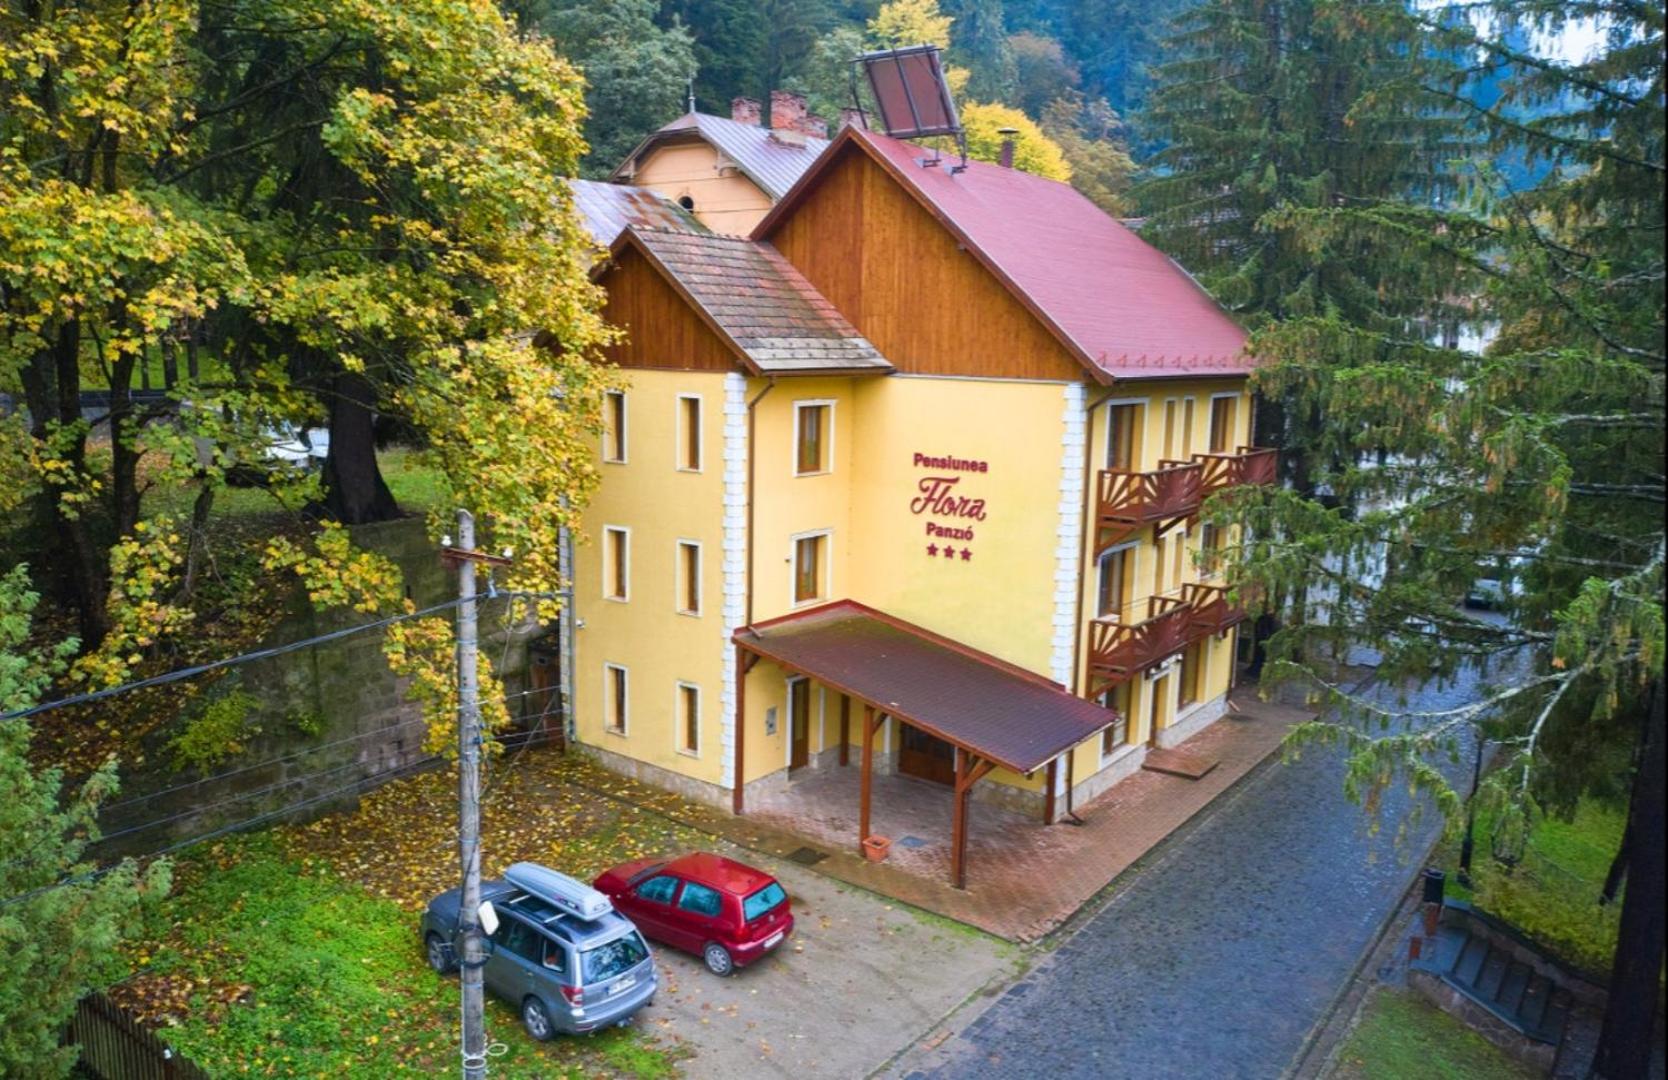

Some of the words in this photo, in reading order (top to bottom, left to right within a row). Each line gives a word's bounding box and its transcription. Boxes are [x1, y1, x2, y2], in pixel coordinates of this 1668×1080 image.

[914, 452, 988, 473] Pensiunea
[910, 476, 987, 522] Flora
[926, 522, 974, 541] Panzió
